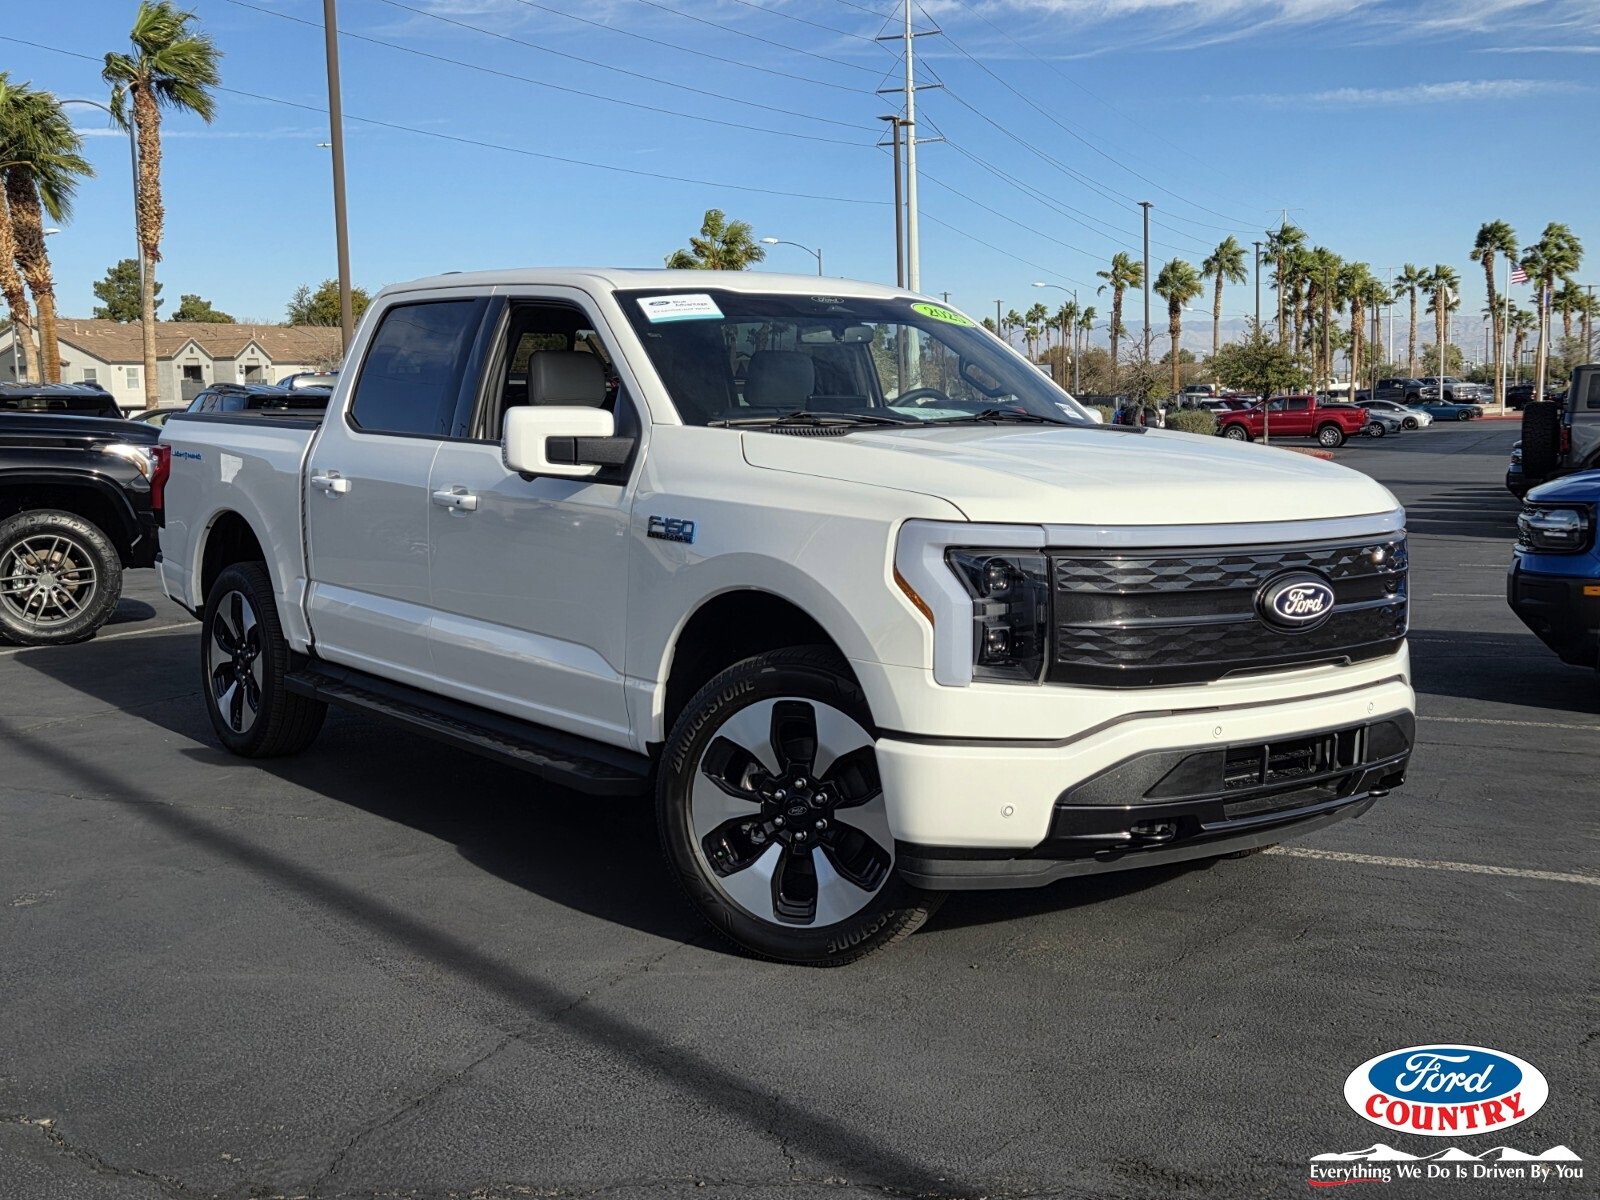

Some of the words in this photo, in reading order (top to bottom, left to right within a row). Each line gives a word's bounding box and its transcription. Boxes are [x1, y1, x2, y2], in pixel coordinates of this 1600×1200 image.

[647, 515, 695, 539] F-150
[1284, 588, 1324, 614] Ford
[672, 676, 755, 774] BRIDGESTONE
